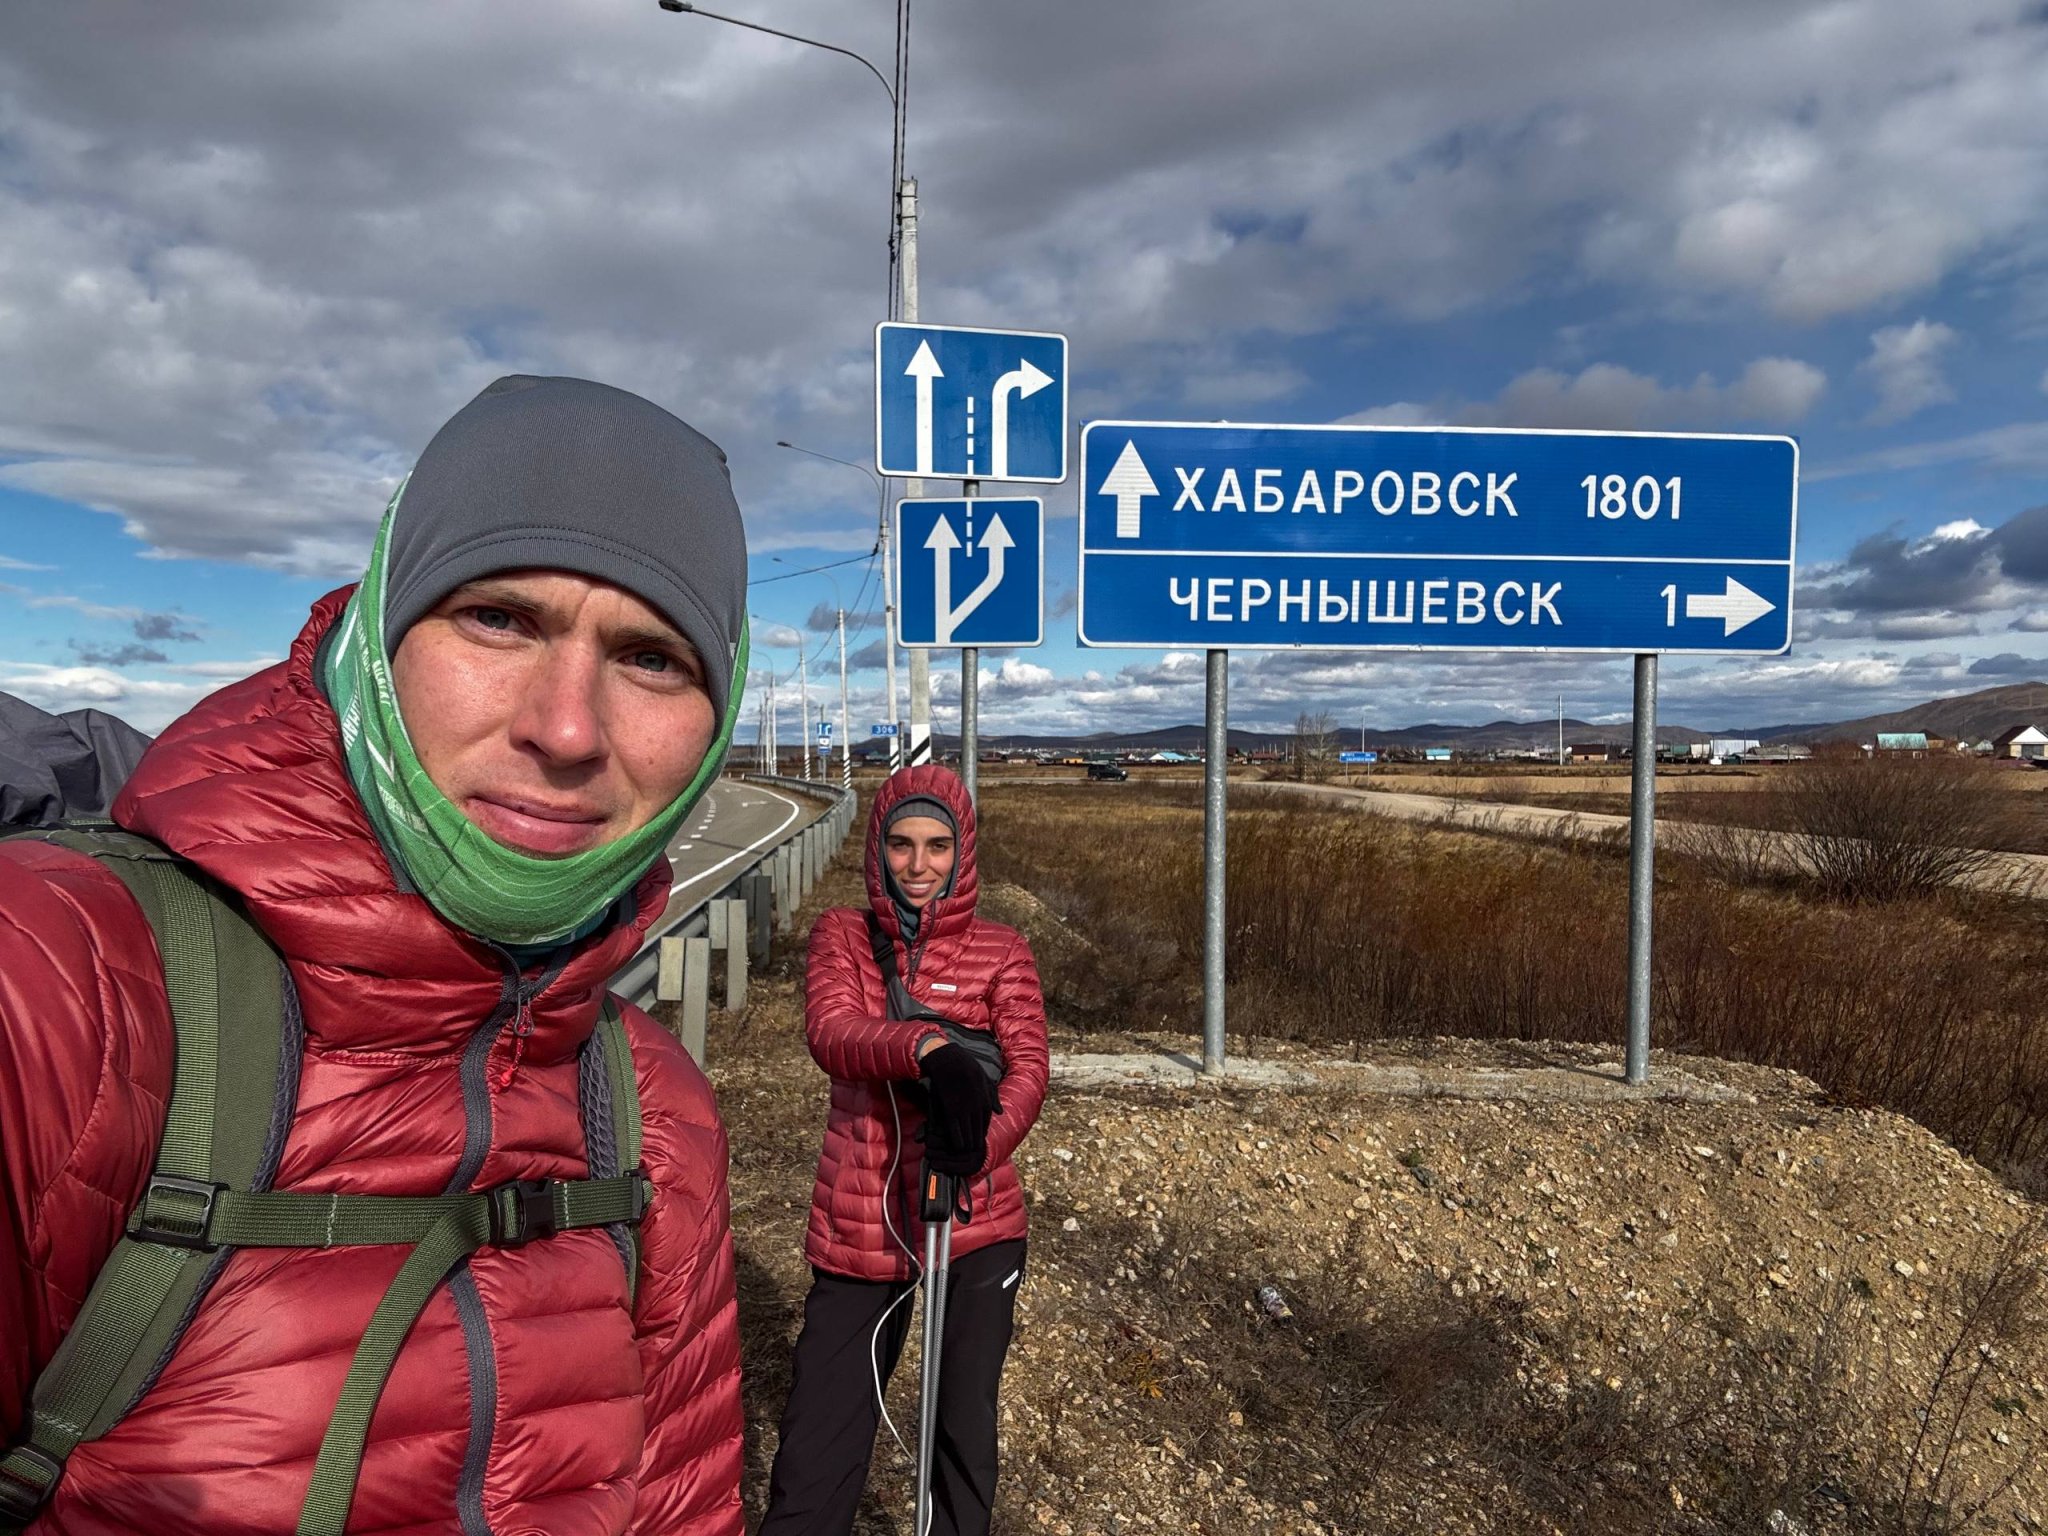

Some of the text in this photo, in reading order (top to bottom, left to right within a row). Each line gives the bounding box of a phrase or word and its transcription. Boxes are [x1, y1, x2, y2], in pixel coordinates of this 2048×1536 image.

[1173, 467, 1681, 521] ХАБАРОВСК 1801
[1169, 578, 1677, 627] ЧЕРНЫШЕВСК 1
